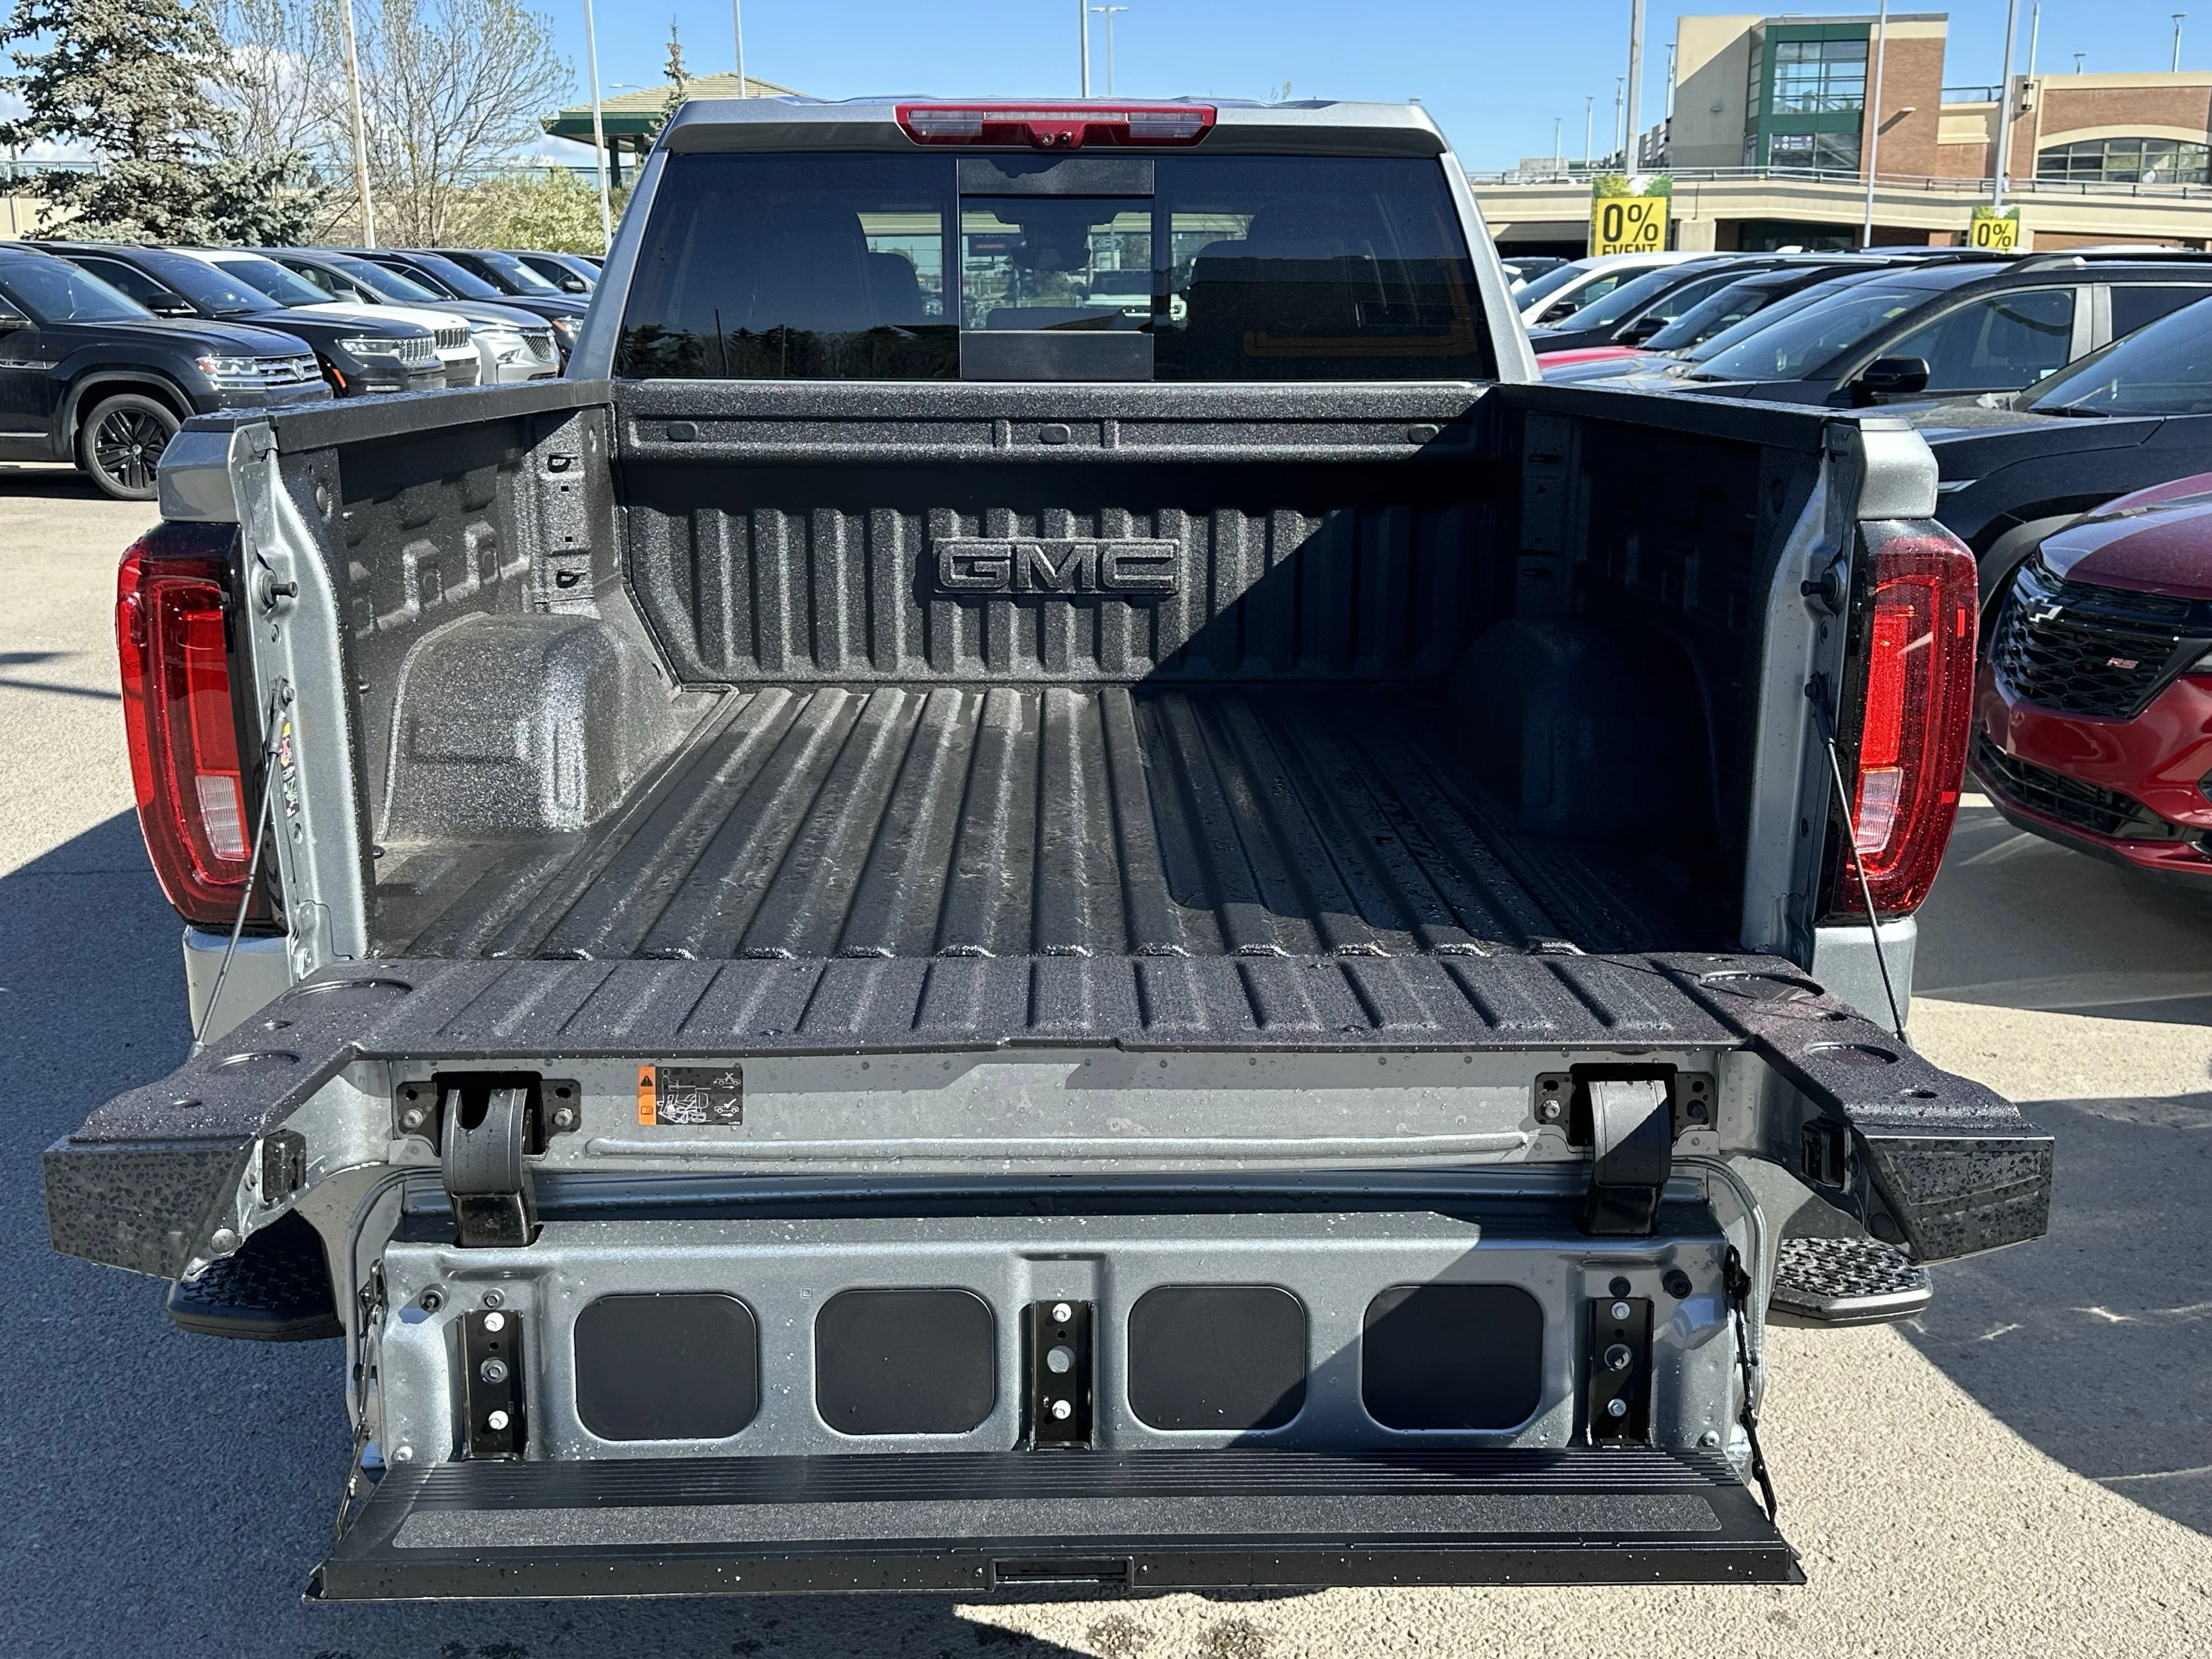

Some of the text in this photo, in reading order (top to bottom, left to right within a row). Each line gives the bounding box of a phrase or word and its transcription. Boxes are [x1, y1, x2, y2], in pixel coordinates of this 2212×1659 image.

[1603, 203, 1658, 242] 0%
[1977, 223, 2011, 247] 0%
[939, 545, 1174, 589] GMC
[2106, 657, 2138, 669] RS
